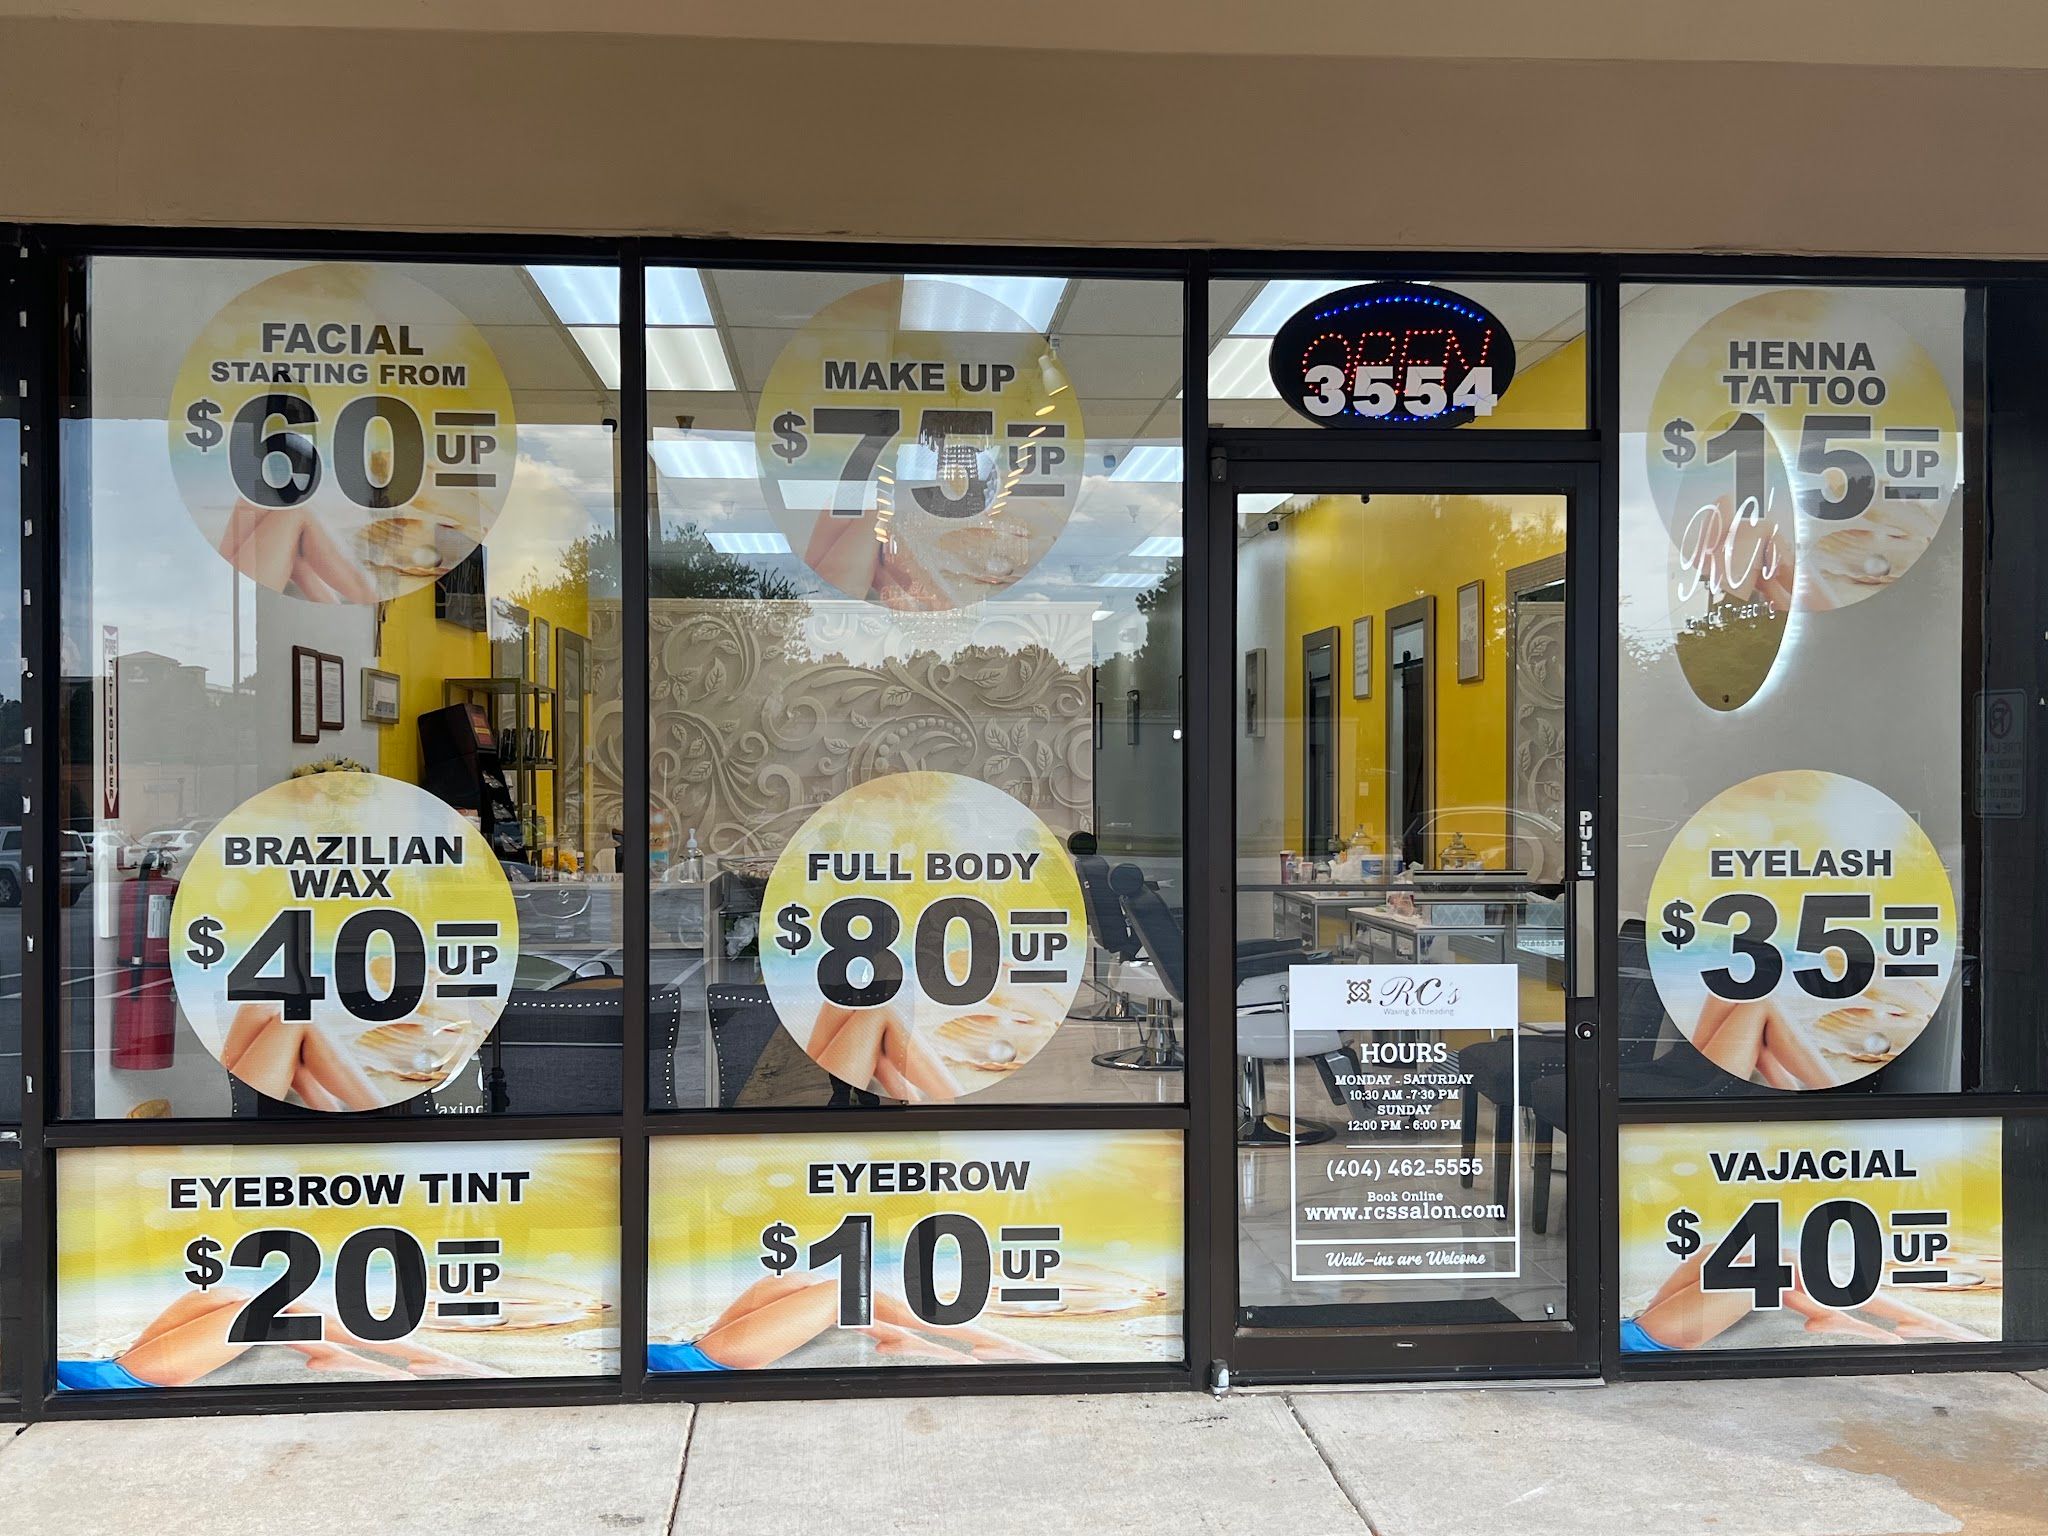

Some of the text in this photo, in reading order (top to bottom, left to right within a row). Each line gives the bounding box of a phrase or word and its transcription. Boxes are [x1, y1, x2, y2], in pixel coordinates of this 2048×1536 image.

[261, 322, 425, 356] FACIAL
[1729, 341, 1876, 371] HENNA
[210, 361, 467, 387] STARTING FROM
[824, 361, 1016, 393] MAKE UP
[1303, 365, 1498, 417] 3554
[1722, 375, 1887, 406] TATTOO
[437, 434, 497, 465] UP
[1008, 445, 1066, 476] UP
[1885, 449, 1940, 478] UP
[223, 836, 463, 866] BRAZILIAN
[1579, 810, 1593, 871] PULL
[808, 852, 1041, 882] FULL BODY
[1710, 849, 1892, 878] EYELASH
[290, 869, 392, 899] WAX
[1010, 931, 1068, 962] UP
[1885, 927, 1939, 957] UP
[437, 944, 498, 976] UP
[1383, 1008, 1410, 1017] Waxing
[1418, 1008, 1455, 1017] Threading
[1360, 1042, 1448, 1064] HOURS
[1335, 1074, 1393, 1086] MONDAY
[1403, 1073, 1474, 1085] SATURDAY
[1350, 1090, 1379, 1101] 10:30
[1382, 1090, 1403, 1101] AM
[1438, 1089, 1460, 1100] PM
[1377, 1104, 1432, 1115] SUNDAY
[1347, 1120, 1378, 1131] 12:00
[1380, 1120, 1402, 1131] PM
[1412, 1120, 1437, 1131] 6:00
[1440, 1119, 1462, 1130] PM
[808, 1161, 1031, 1195] EYEBROW
[1326, 1158, 1484, 1182] (404) 462-5555
[1709, 1149, 1917, 1182] VAJACIAL
[170, 1171, 530, 1209] EYEBROW TINT
[1367, 1191, 1444, 1202] Book Online
[1304, 1202, 1506, 1221] www.rcssalon.com
[1325, 1250, 1487, 1267] Walk-ins are Welcome
[1892, 1233, 1948, 1263] UP
[438, 1262, 501, 1294] UP
[1002, 1249, 1061, 1280] UP
